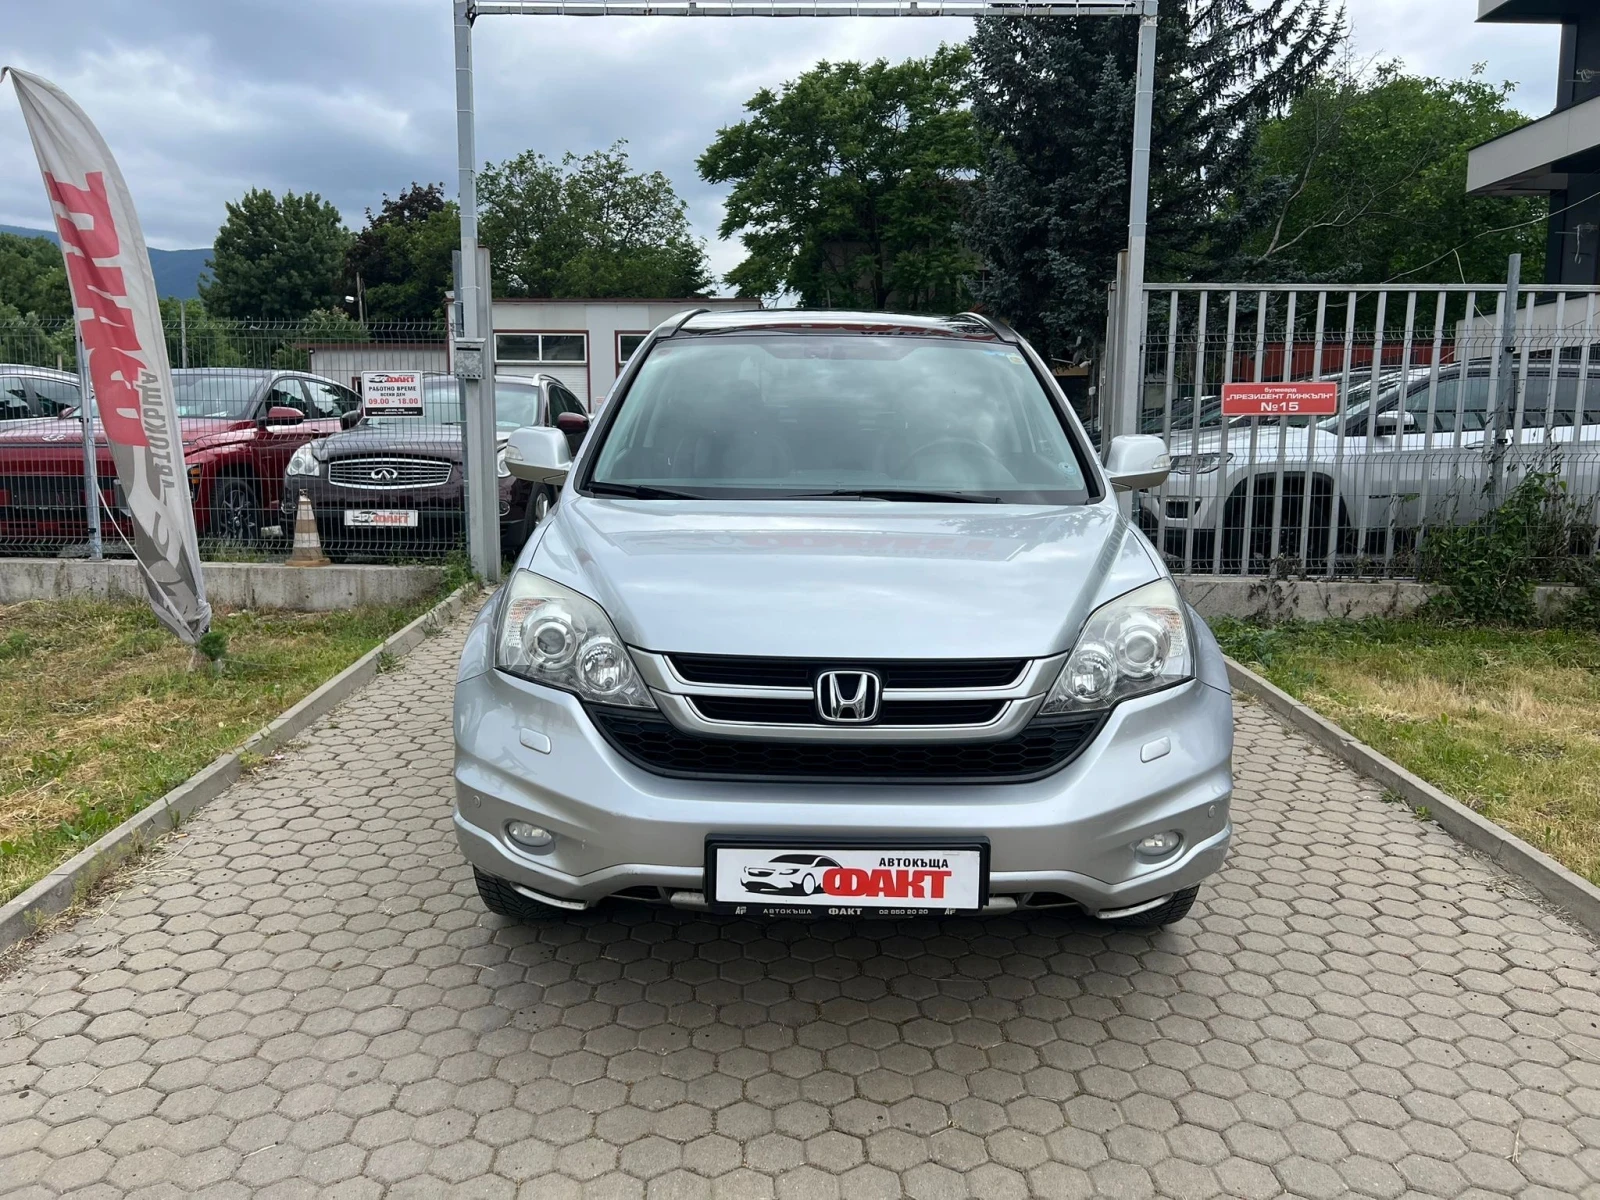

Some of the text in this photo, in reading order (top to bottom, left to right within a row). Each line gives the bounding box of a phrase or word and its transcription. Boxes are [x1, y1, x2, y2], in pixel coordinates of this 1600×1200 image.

[878, 857, 949, 870] АВТОКЪЩА
[822, 868, 952, 898] ФАКТ
[828, 907, 862, 915] ФАКТ
